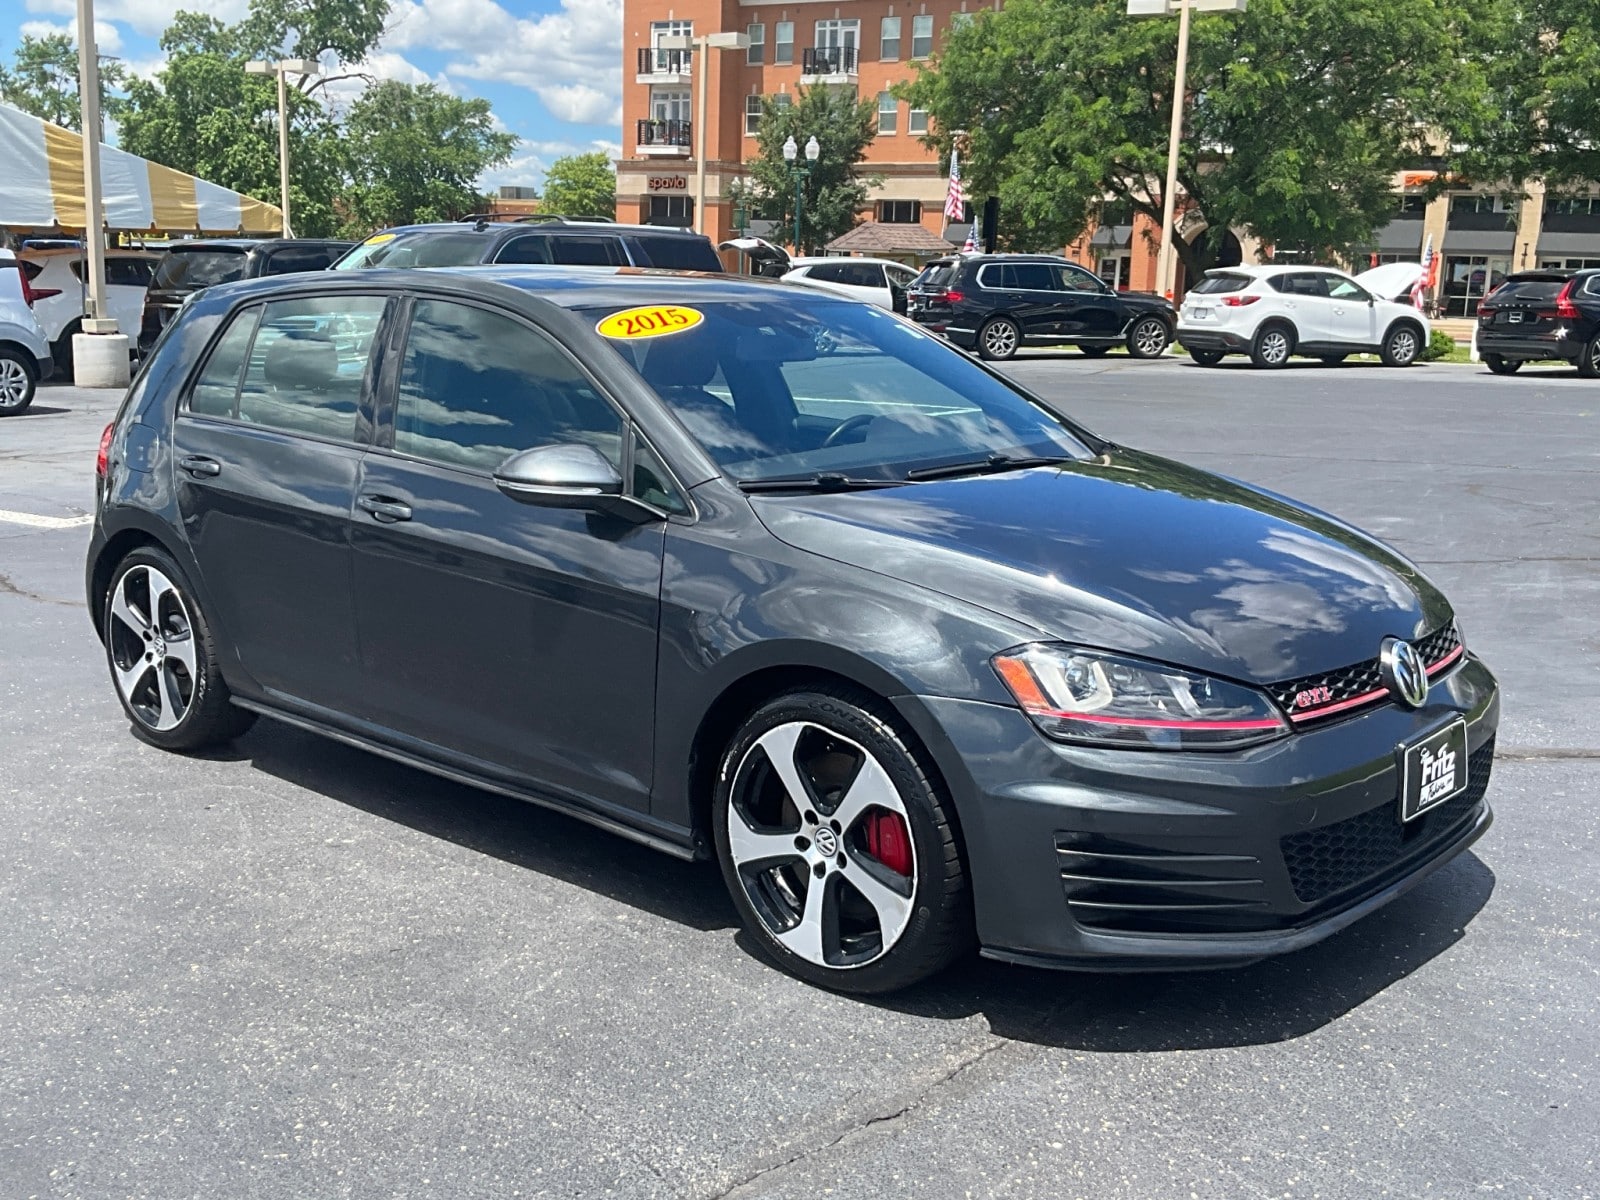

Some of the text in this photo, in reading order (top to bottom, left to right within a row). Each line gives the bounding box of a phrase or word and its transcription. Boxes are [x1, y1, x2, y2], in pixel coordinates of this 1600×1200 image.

[617, 309, 689, 335] 2015
[1296, 686, 1331, 708] GTI
[1420, 743, 1456, 787] Fritz
